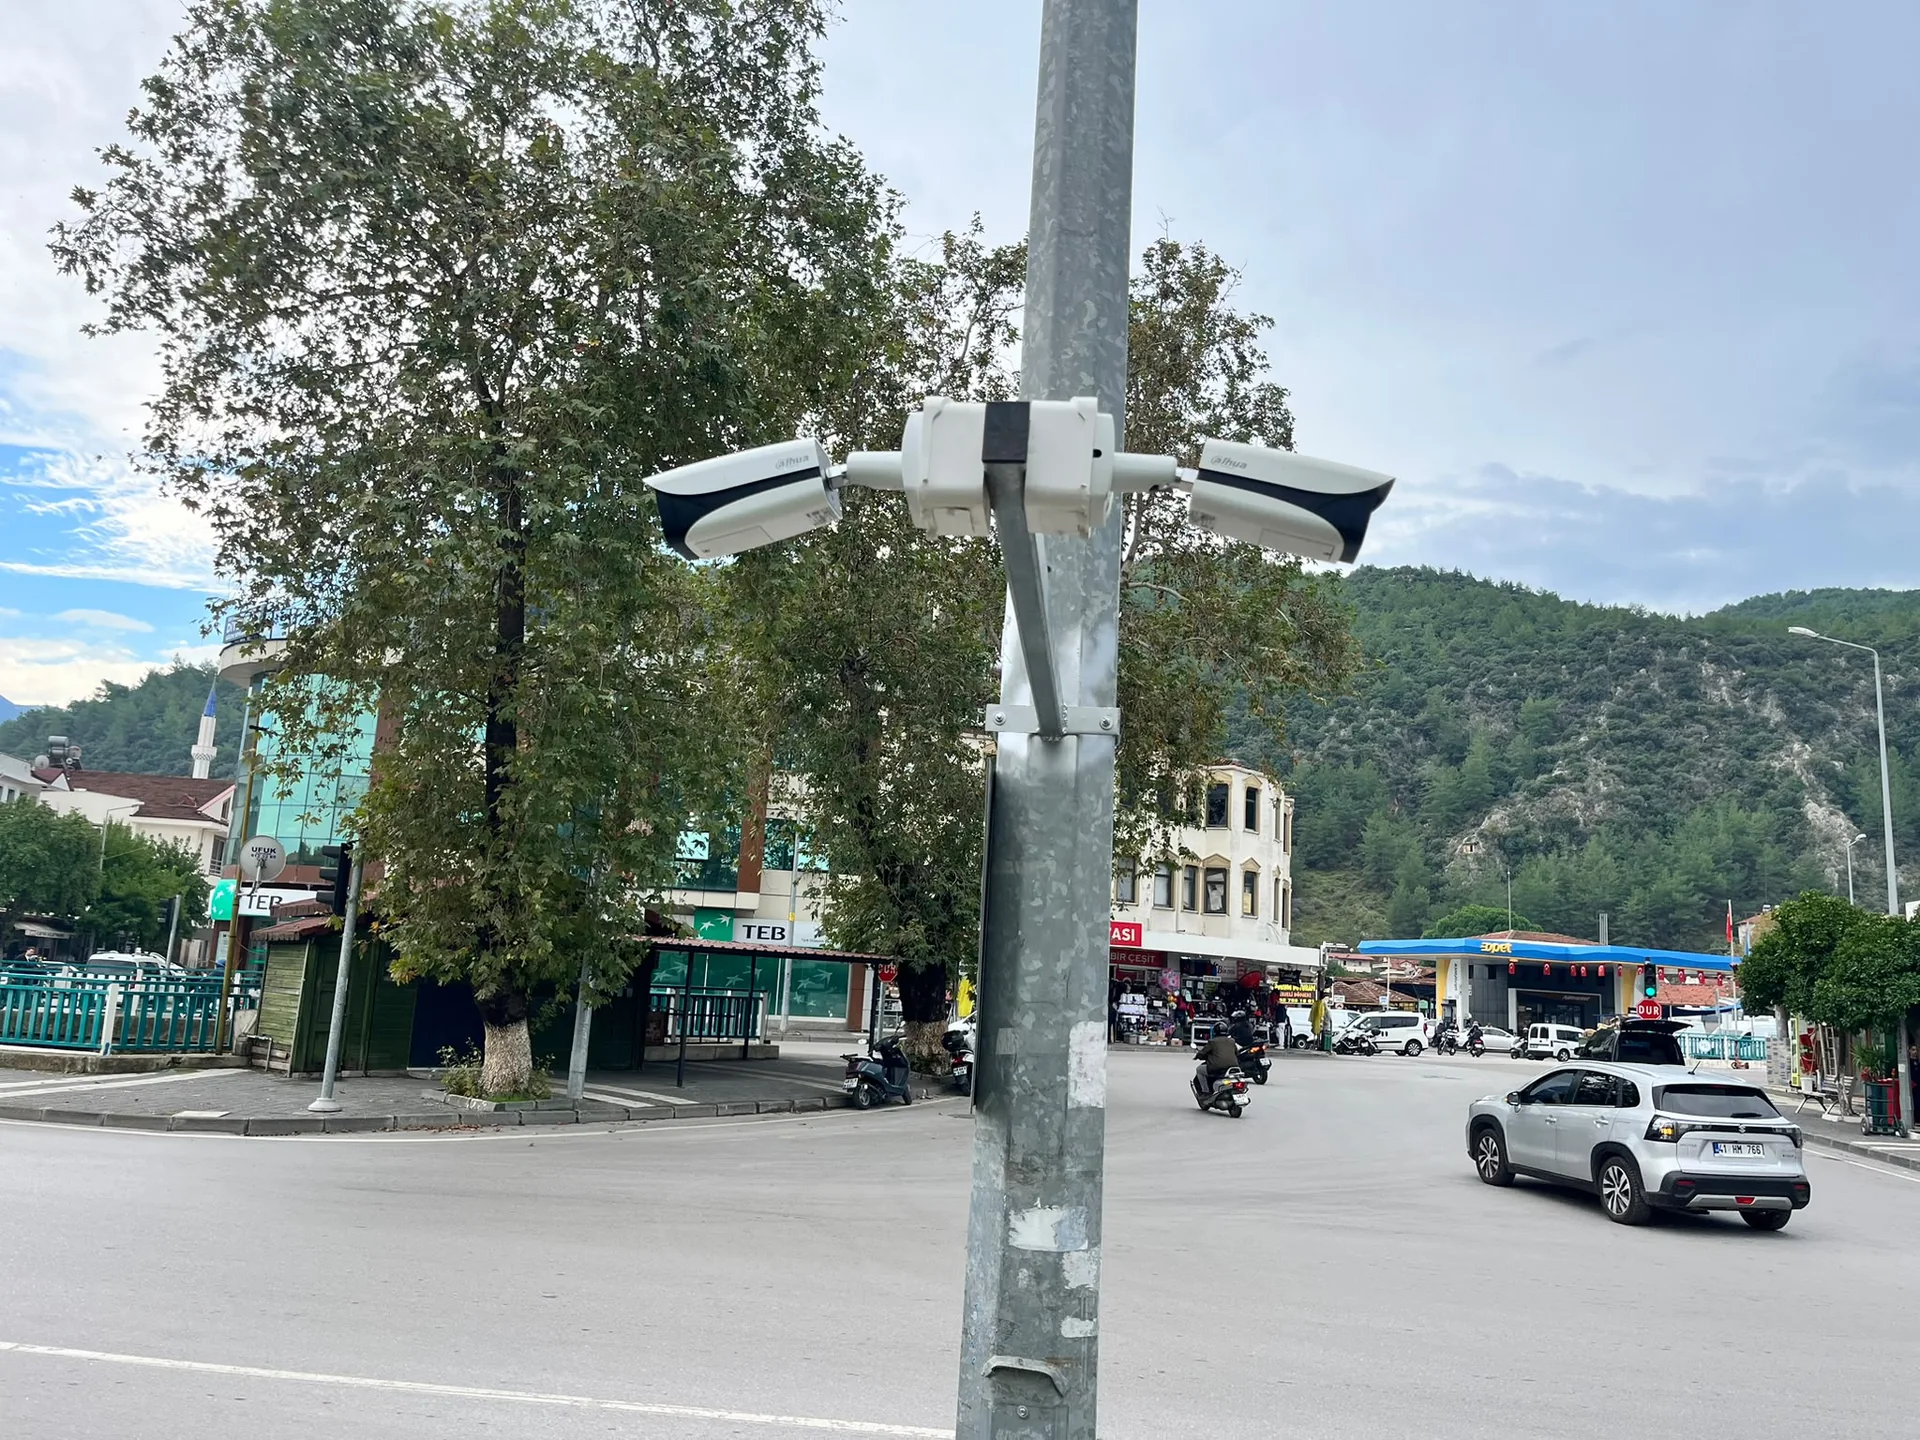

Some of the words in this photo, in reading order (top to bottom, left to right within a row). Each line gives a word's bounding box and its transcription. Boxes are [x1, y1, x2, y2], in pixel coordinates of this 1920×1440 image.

[251, 846, 276, 854] UFUK
[247, 894, 283, 910] TEB
[742, 924, 786, 940] TEB
[1110, 927, 1136, 942] ASI
[1638, 1005, 1660, 1016] DUR
